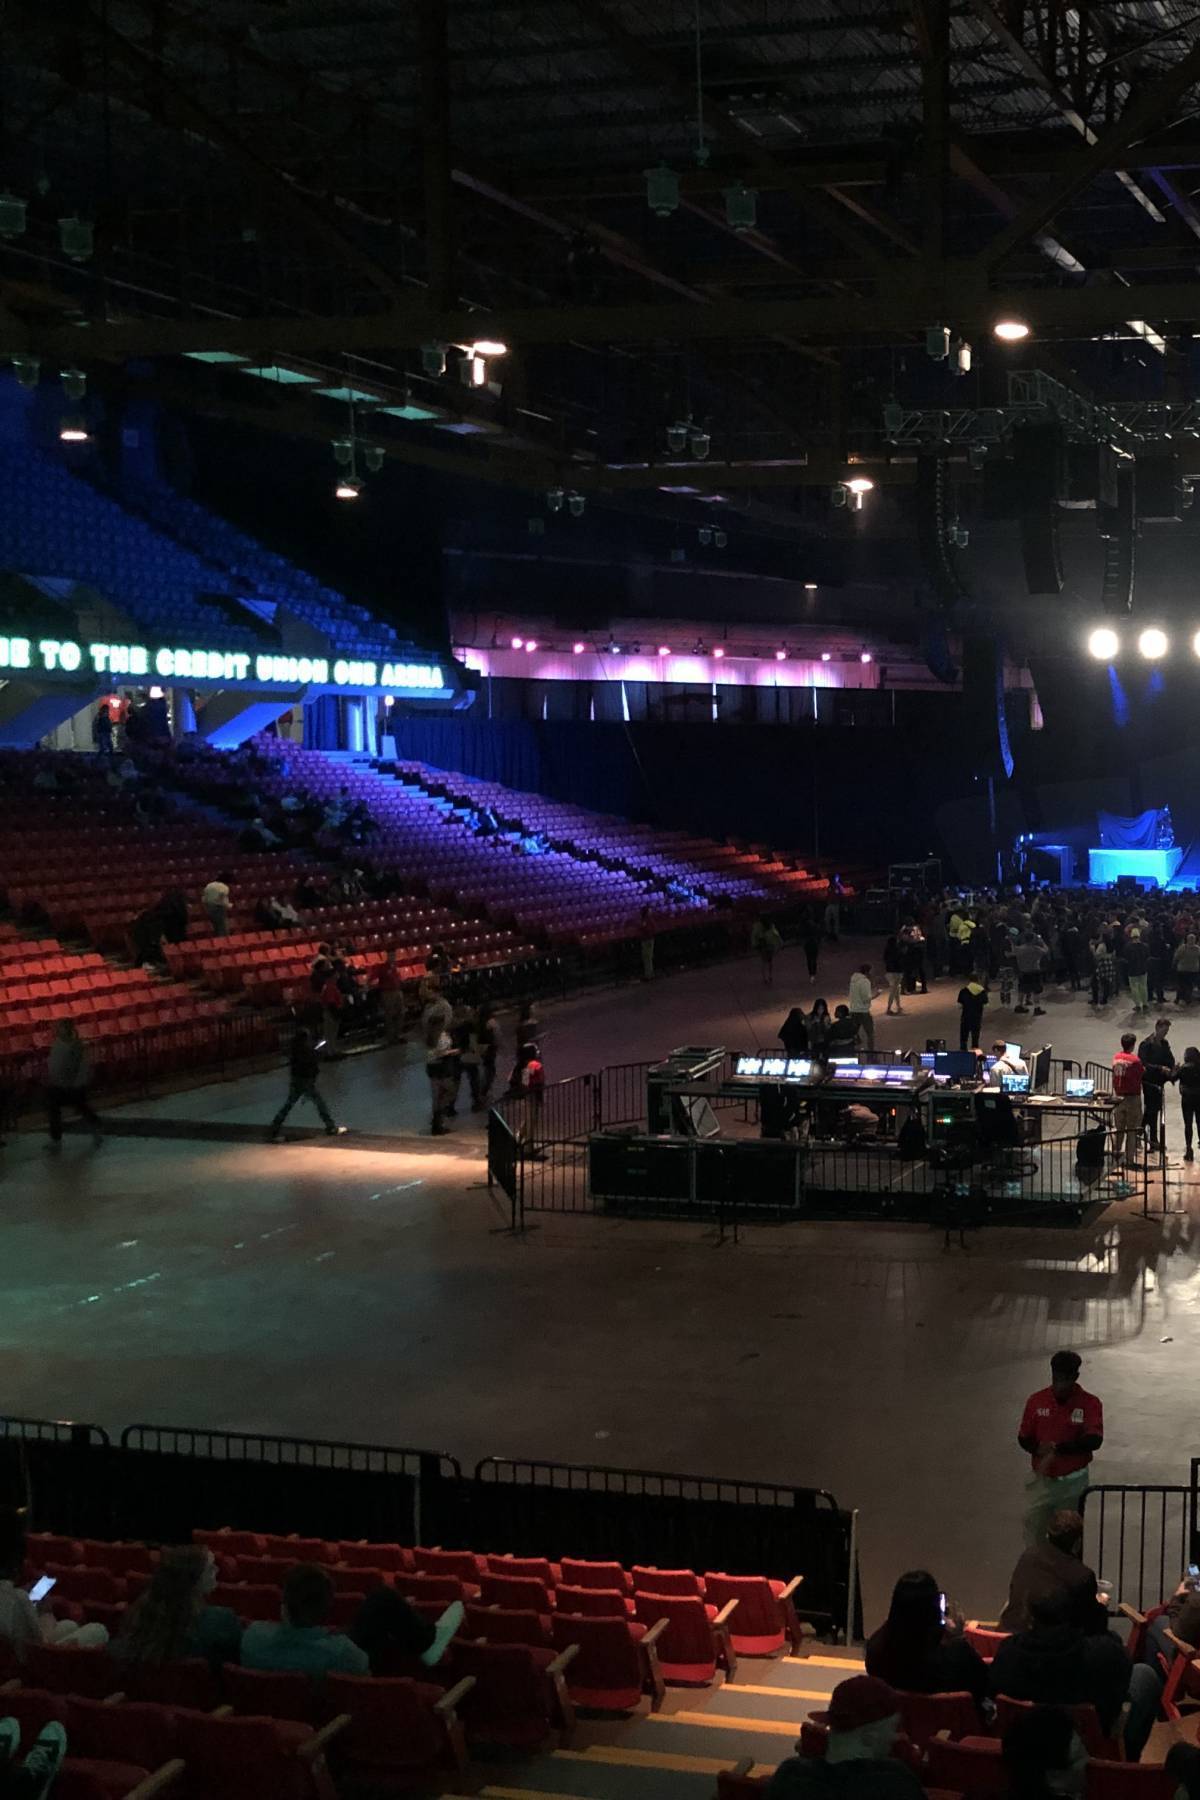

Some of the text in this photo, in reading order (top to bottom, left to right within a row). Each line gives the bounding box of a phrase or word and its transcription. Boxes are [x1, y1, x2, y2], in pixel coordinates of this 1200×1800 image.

[40, 640, 82, 671] TO
[90, 643, 148, 675] THE
[156, 648, 250, 680] CREDIT
[256, 654, 328, 683] UNION
[333, 659, 376, 687] ONE
[381, 663, 445, 689] ARENA
